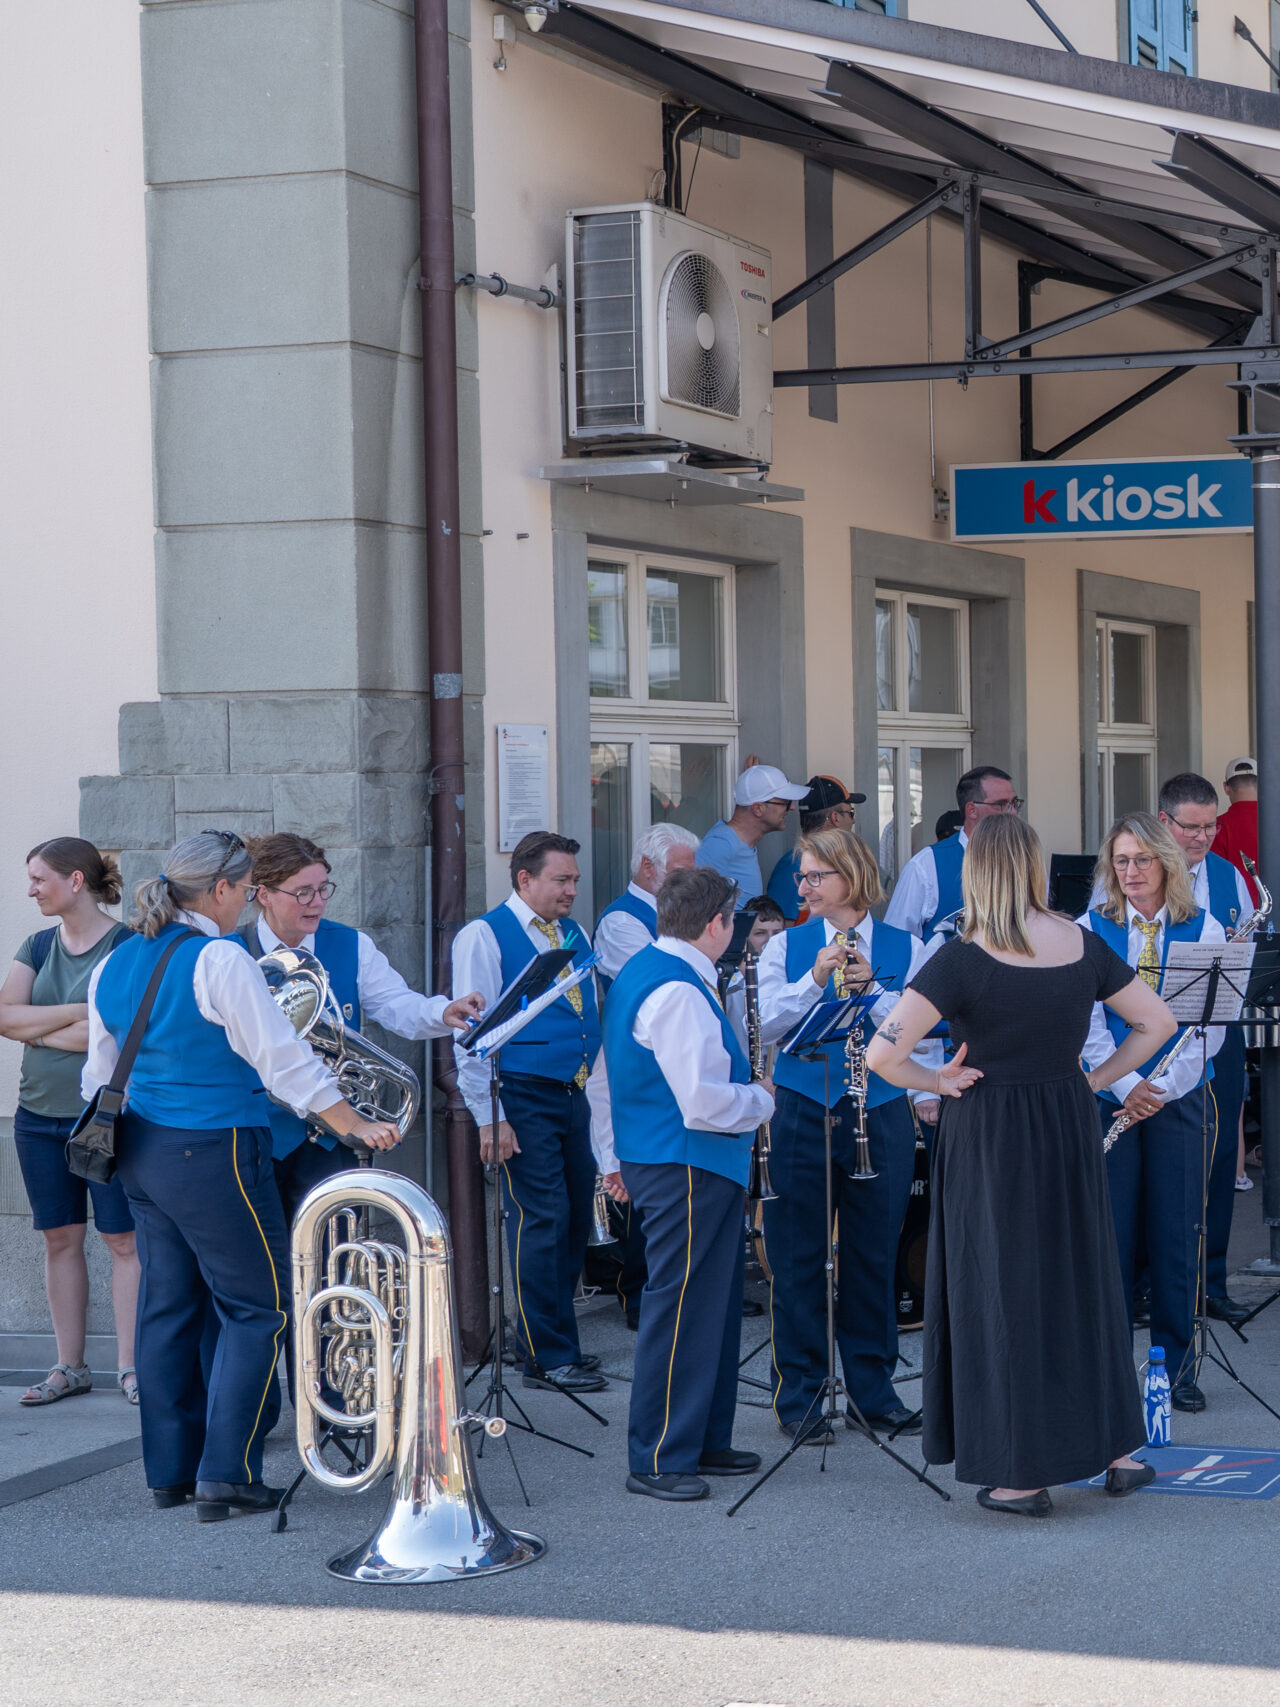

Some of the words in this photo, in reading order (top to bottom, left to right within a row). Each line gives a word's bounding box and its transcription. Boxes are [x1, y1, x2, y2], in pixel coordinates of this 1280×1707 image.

[740, 261, 766, 279] TOSHIBA
[1023, 479, 1059, 523] k
[1066, 473, 1223, 522] kiosk
